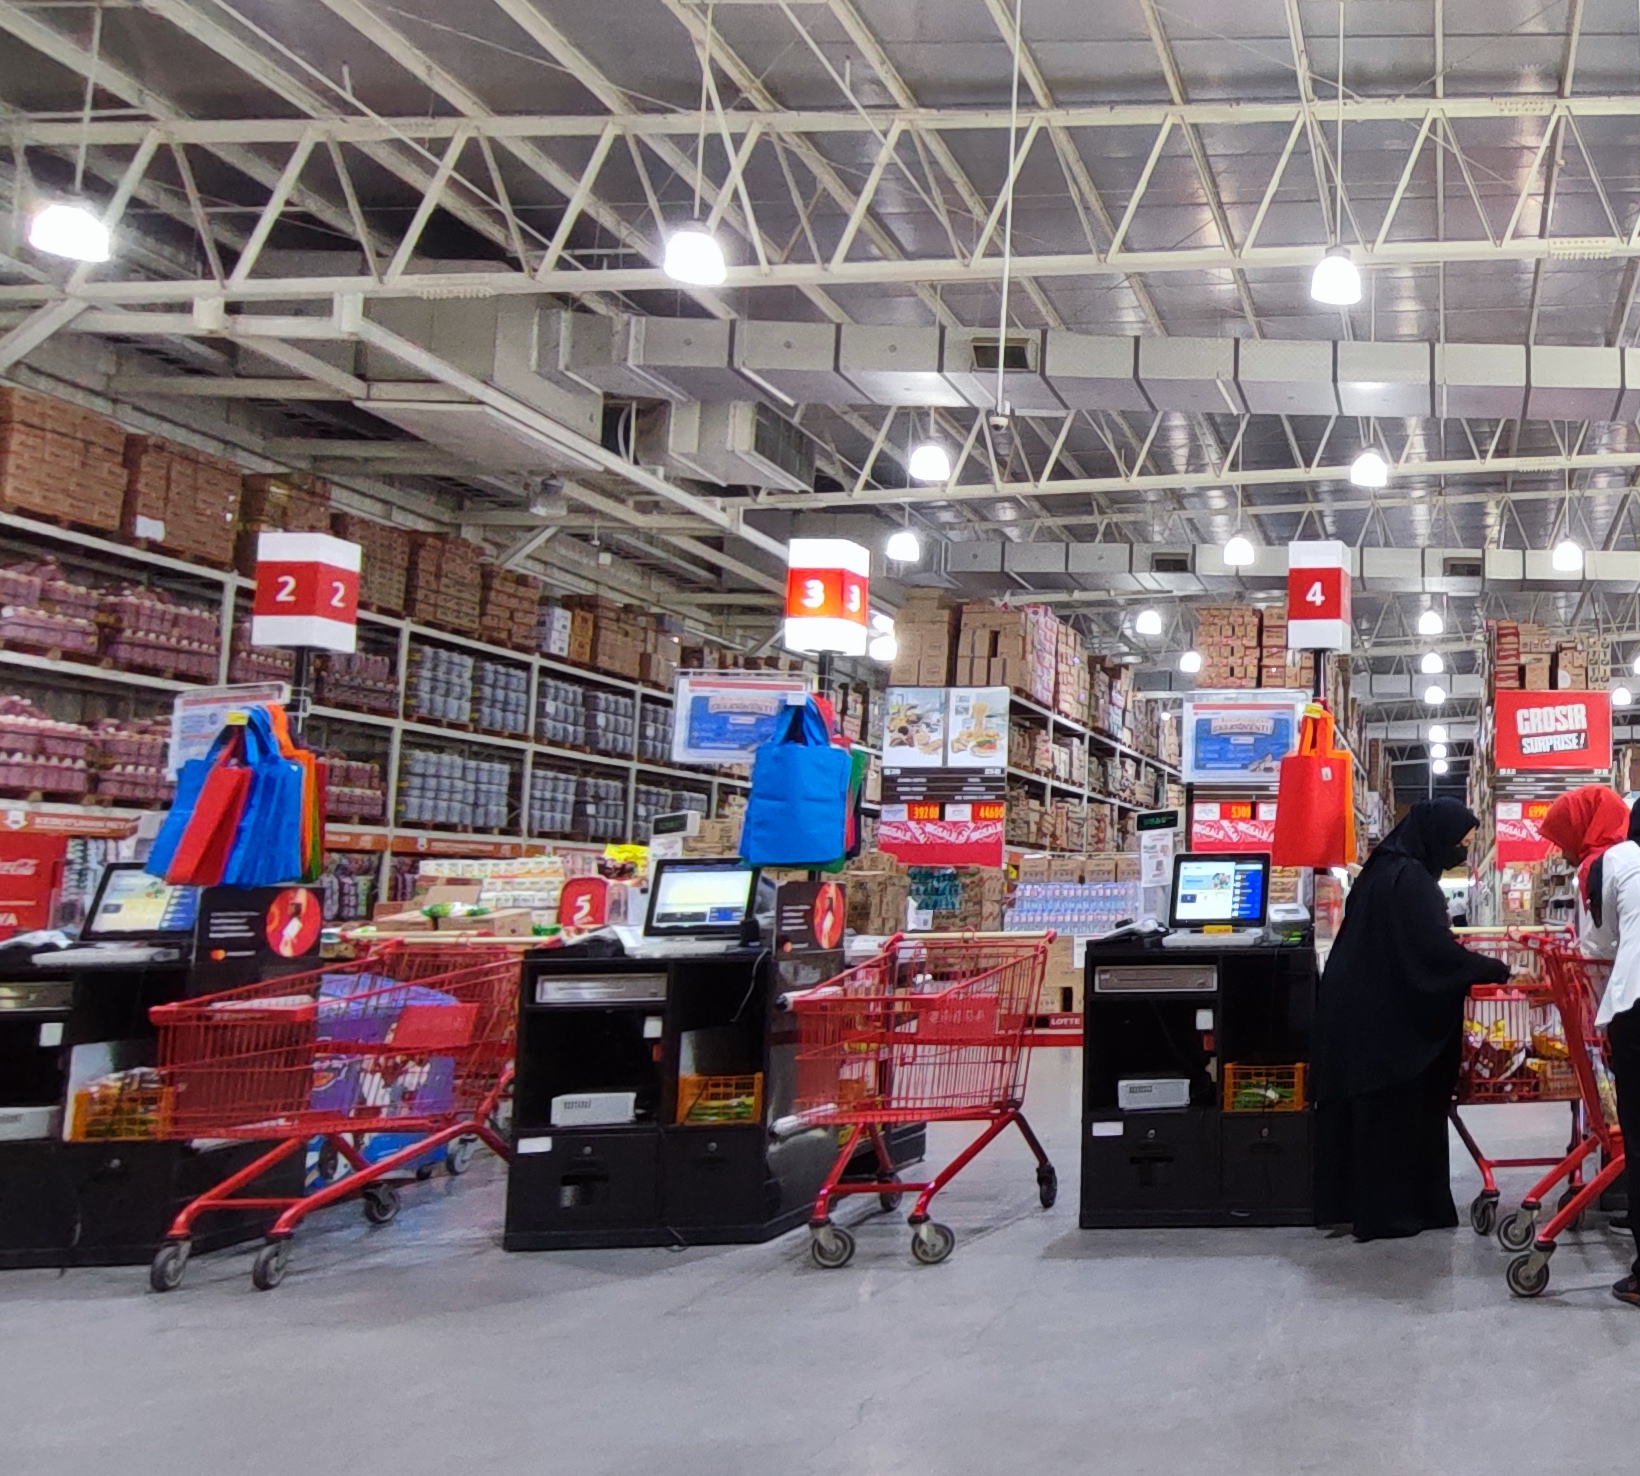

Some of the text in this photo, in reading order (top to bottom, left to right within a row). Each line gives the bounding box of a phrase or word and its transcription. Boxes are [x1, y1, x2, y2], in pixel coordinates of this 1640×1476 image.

[276, 575, 296, 602] 2
[330, 581, 345, 608] 2
[802, 579, 825, 609] 3
[847, 584, 861, 613] 3
[1305, 581, 1326, 607] 4
[1516, 703, 1588, 735] GROSIR
[1050, 1017, 1081, 1026] LOTTE
